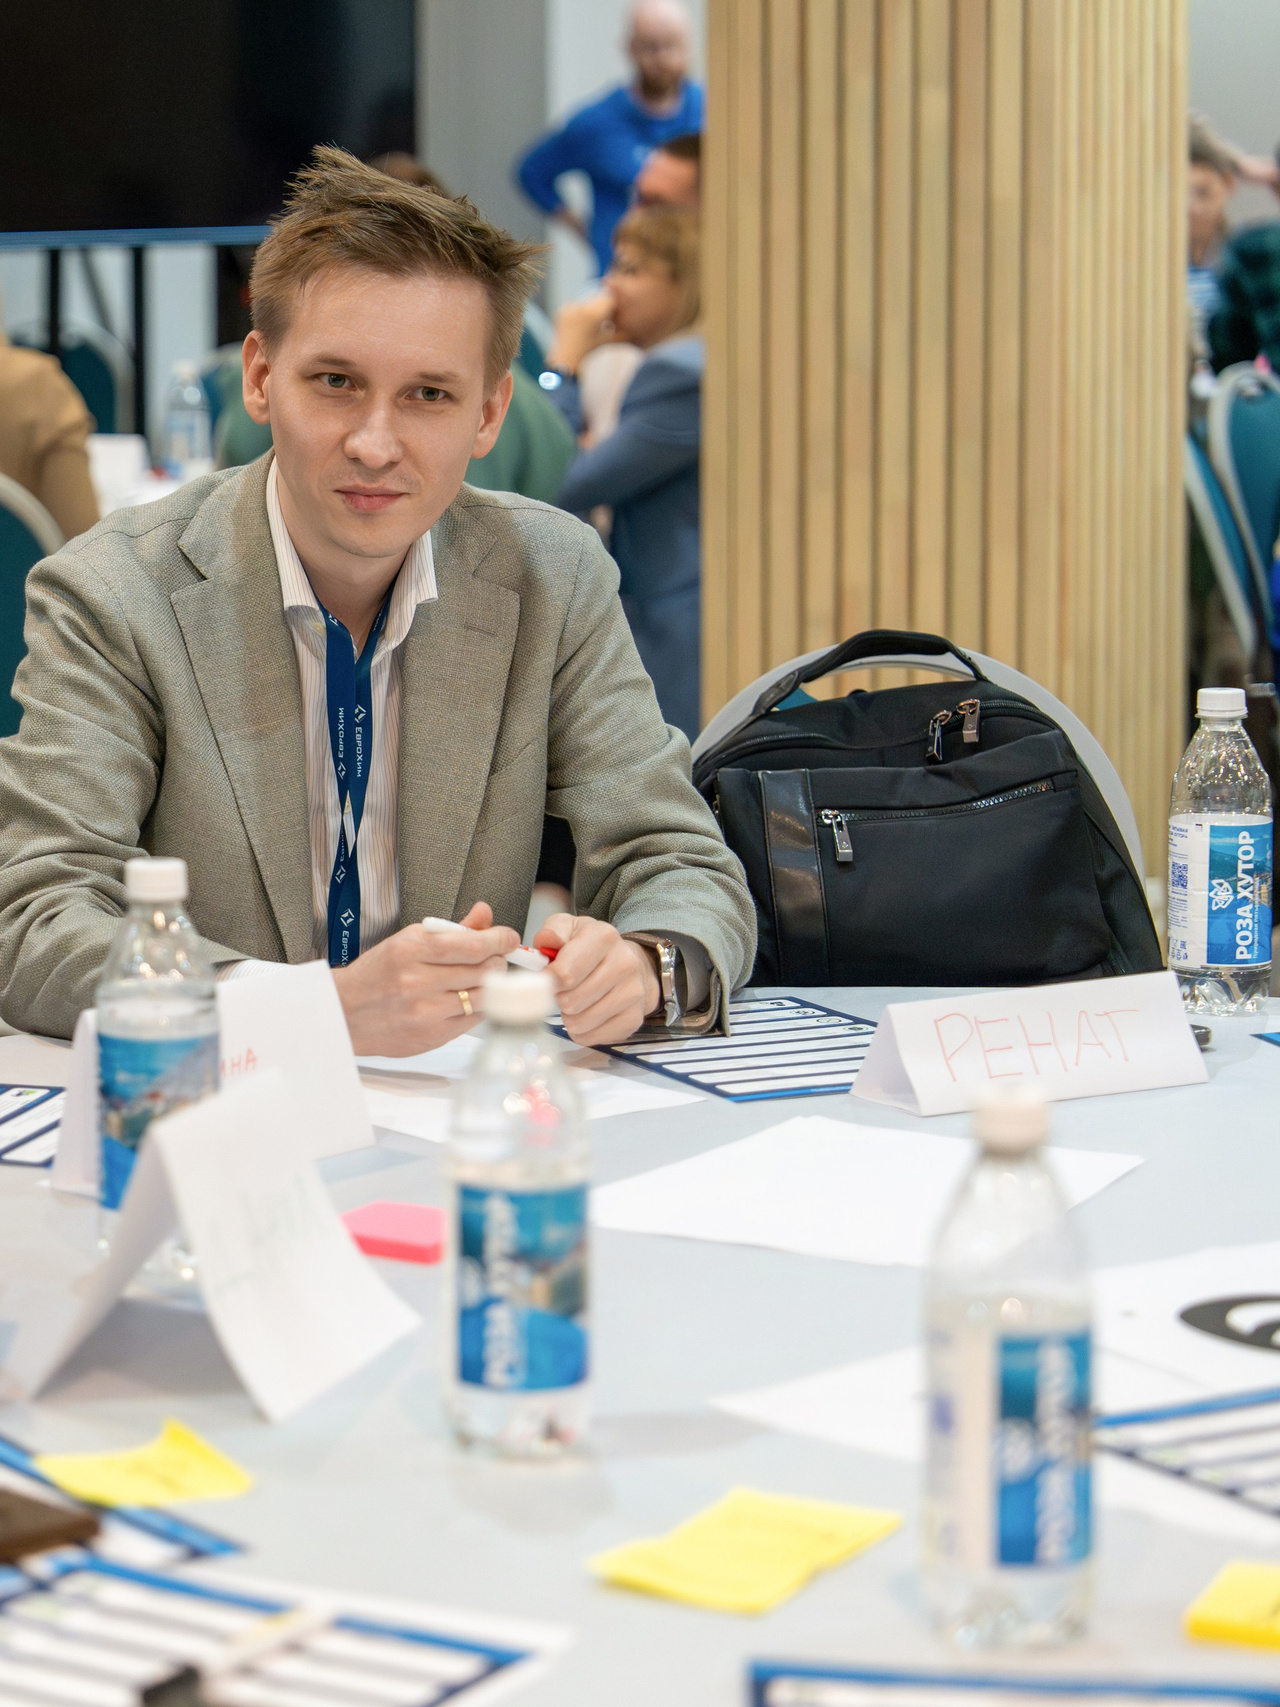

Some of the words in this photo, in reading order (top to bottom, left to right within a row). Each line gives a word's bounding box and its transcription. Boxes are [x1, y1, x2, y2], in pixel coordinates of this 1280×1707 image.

[337, 707, 345, 758] ЕВРОХИМ
[355, 726, 363, 778] ЕВРОХИМ
[1236, 830, 1255, 900] ХУТОР
[1235, 904, 1254, 960] РОЗА
[933, 1008, 1140, 1083] РЕНАТ
